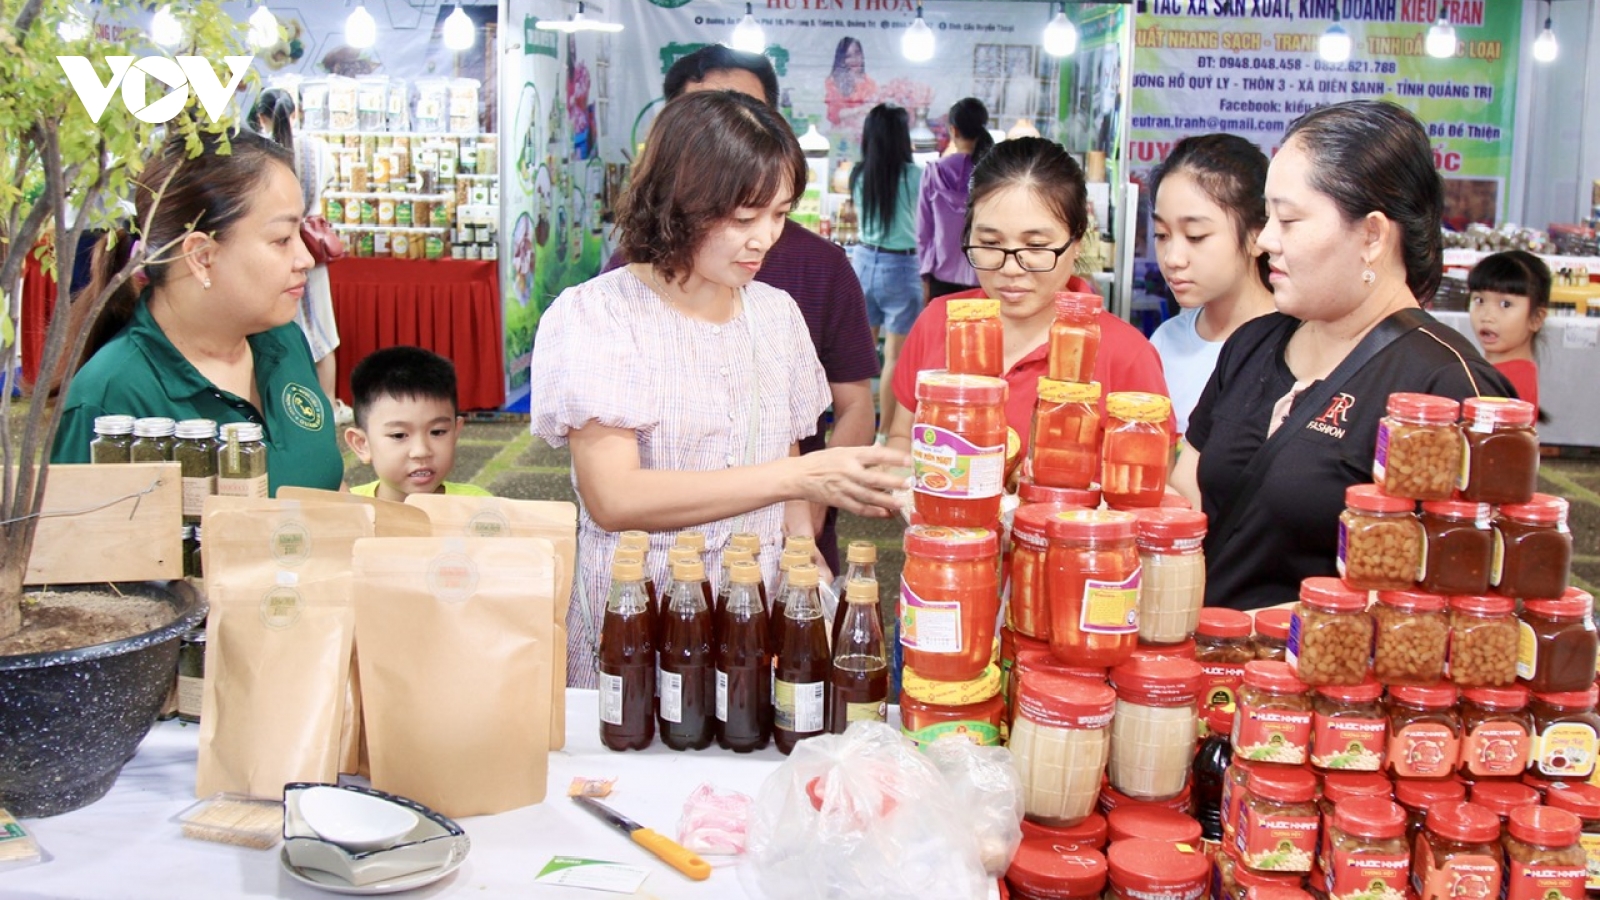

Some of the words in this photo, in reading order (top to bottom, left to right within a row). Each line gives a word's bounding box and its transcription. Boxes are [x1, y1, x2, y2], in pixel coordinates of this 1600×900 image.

[1343, 0, 1396, 21] DOANH
[1168, 30, 1219, 48] NHANG
[1223, 32, 1261, 53] SẠCH
[1366, 36, 1400, 54] TINH
[1469, 40, 1501, 62] LOẠI
[1219, 57, 1302, 71] 0948.048.458
[1132, 73, 1165, 88] ƯỜNG
[1216, 77, 1230, 90] LY
[1242, 75, 1275, 91] THÔN
[1278, 79, 1286, 91] 3
[1350, 81, 1384, 94] SANH
[1428, 80, 1470, 98] QUẢNG
[1474, 84, 1493, 102] TRỊ
[1219, 99, 1281, 113] Facebook:
[1132, 116, 1285, 132] eutran.tranh@gmail.com
[1468, 125, 1500, 142] Thiện
[1306, 420, 1346, 439] FASHION
